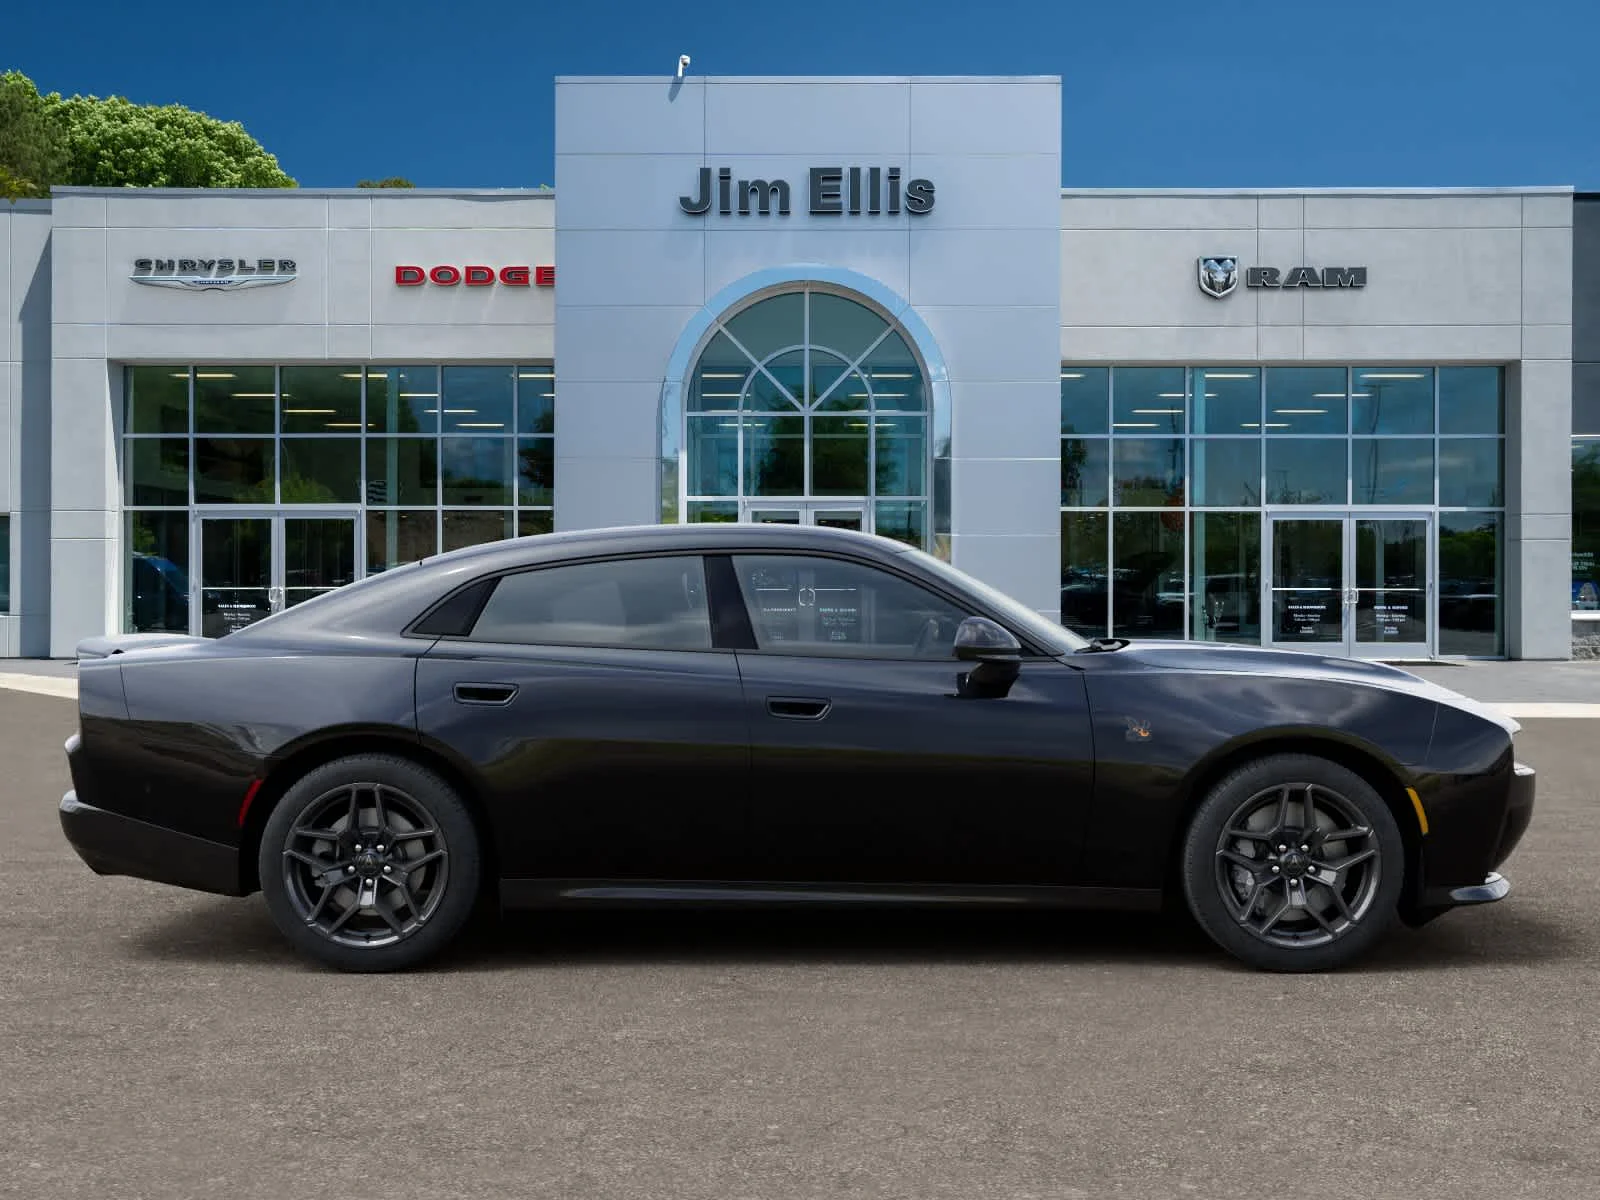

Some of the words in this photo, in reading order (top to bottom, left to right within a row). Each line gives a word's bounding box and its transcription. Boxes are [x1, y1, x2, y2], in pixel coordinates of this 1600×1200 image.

[679, 167, 790, 214] Jim
[809, 167, 936, 214] Ellis
[134, 258, 297, 272] CHRYSLER
[395, 265, 555, 286] DODGE
[1246, 266, 1368, 288] RAM
